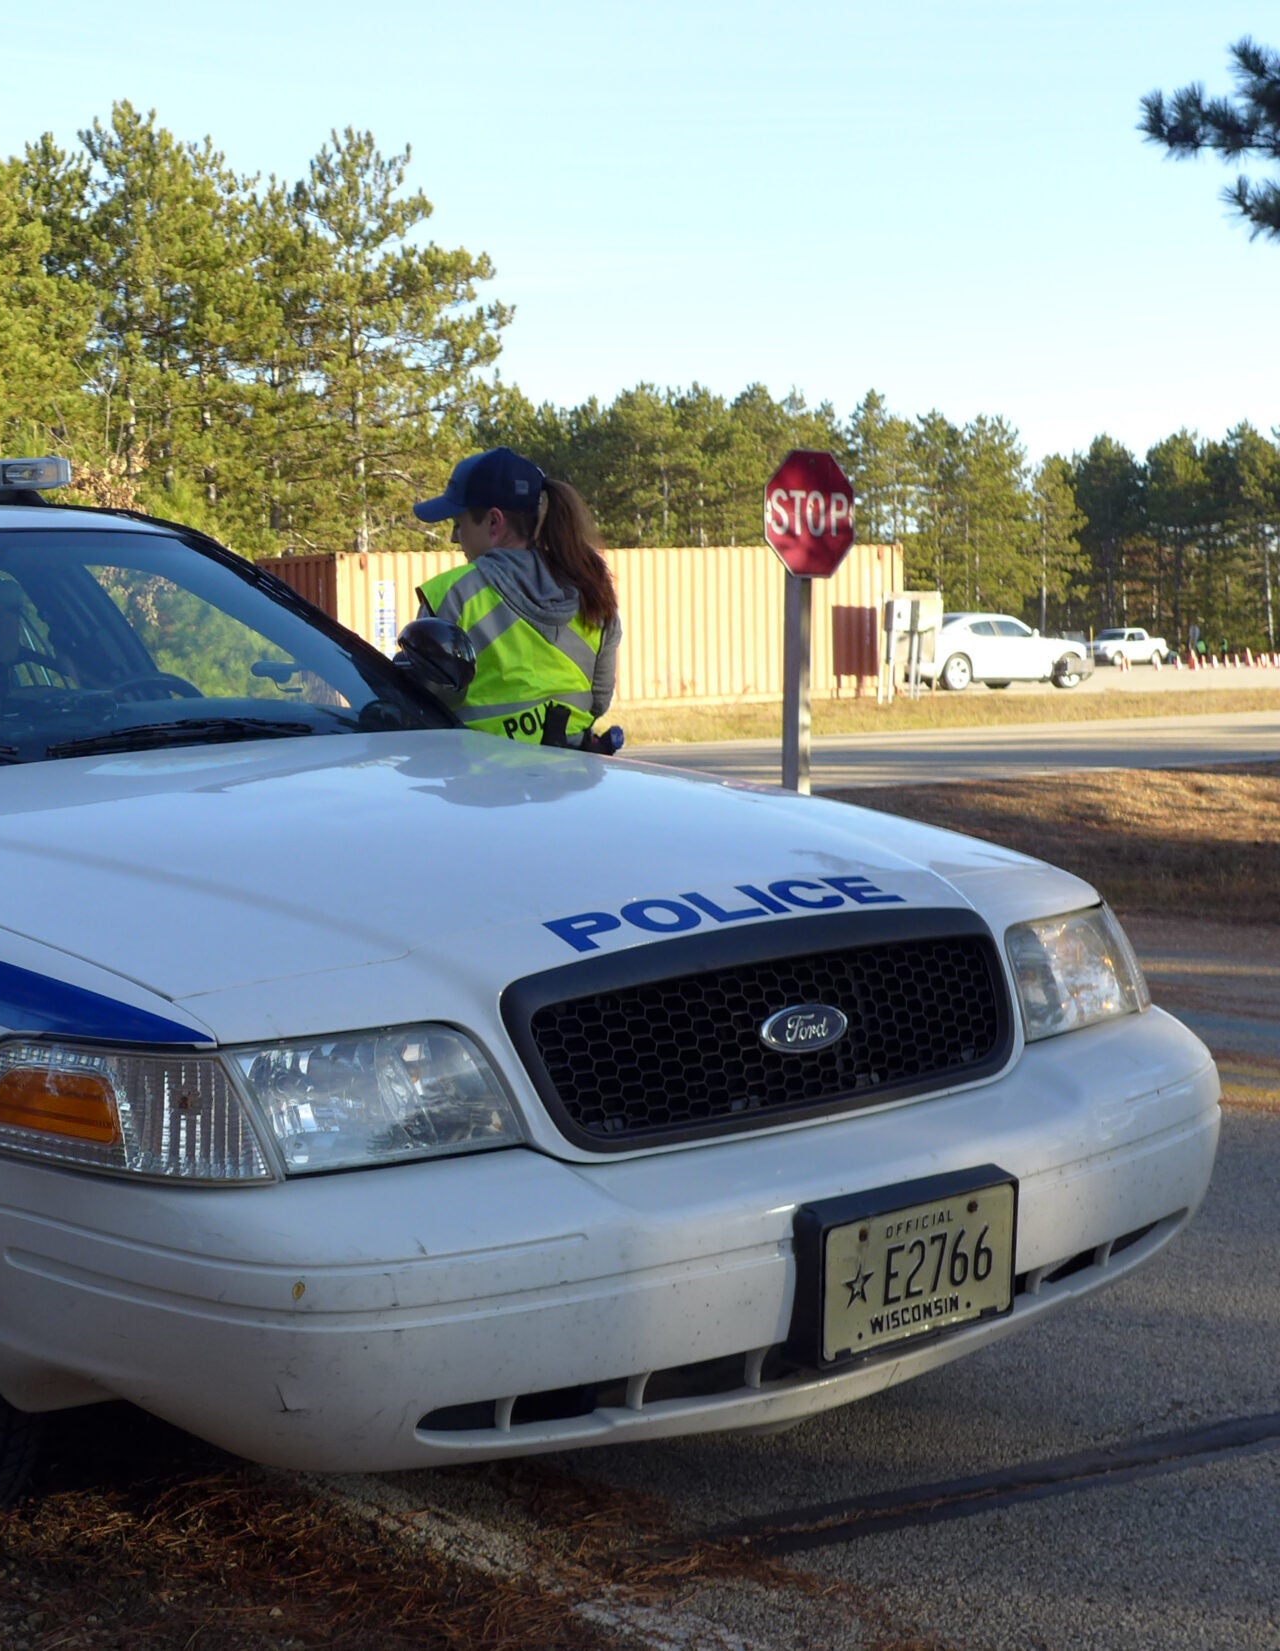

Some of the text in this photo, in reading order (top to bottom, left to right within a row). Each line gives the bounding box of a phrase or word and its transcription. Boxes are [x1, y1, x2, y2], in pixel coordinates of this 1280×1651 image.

[771, 488, 848, 537] STOP
[542, 876, 907, 952] POLICE
[785, 1013, 829, 1042] Ford
[886, 1210, 953, 1239] OFFICIAL
[882, 1225, 993, 1307] E2766
[870, 1295, 959, 1335] WISCONSIN
